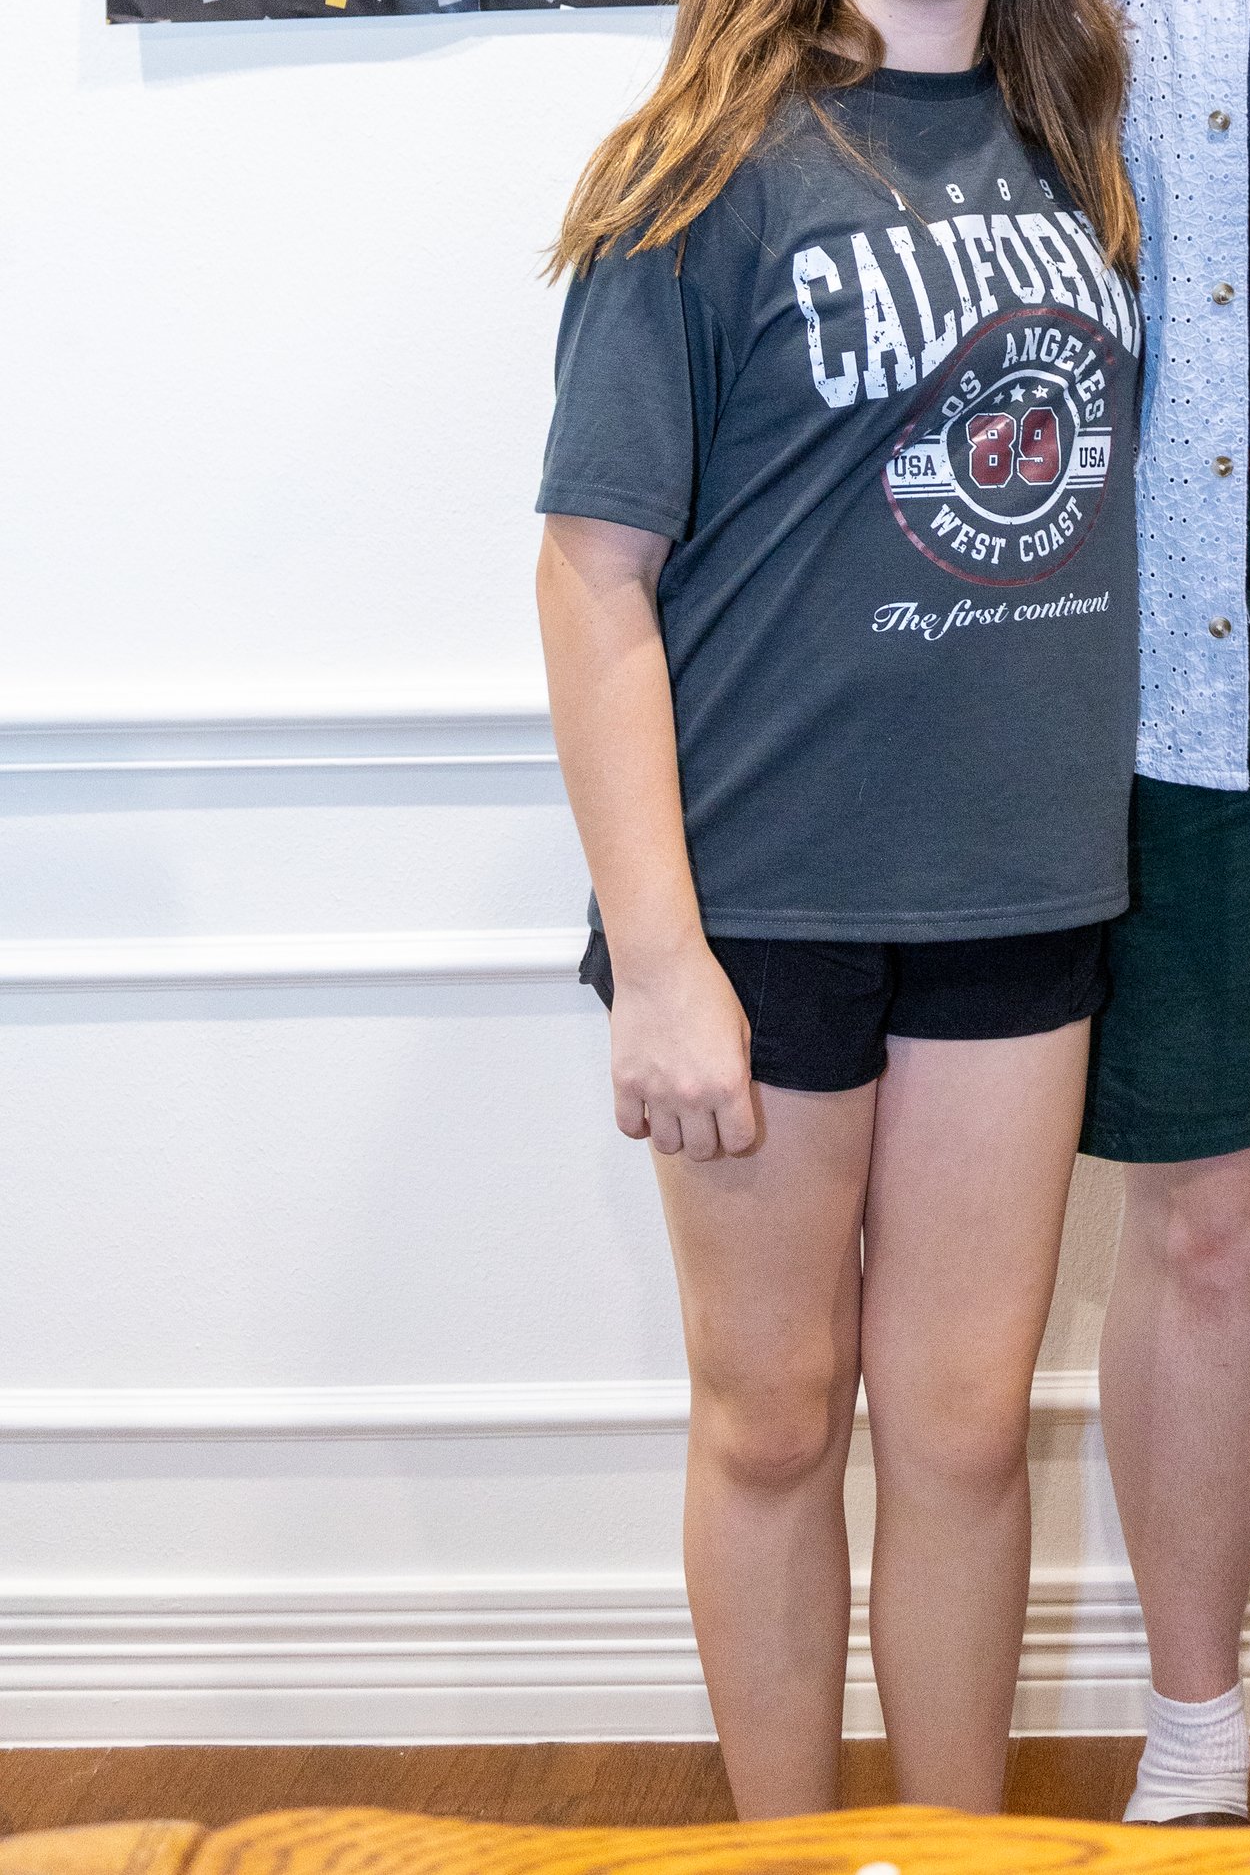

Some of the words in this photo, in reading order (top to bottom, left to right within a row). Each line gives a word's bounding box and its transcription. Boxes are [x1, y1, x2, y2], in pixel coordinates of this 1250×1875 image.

[942, 370, 982, 418] OS
[1002, 327, 1106, 423] ANGELES
[894, 455, 938, 478] USA
[965, 406, 1062, 489] 89
[1079, 447, 1106, 469] USA
[930, 503, 1007, 564] WEST
[1018, 496, 1083, 563] COAST
[872, 601, 942, 632] The
[923, 598, 1010, 641] first
[1013, 591, 1109, 621] continent
